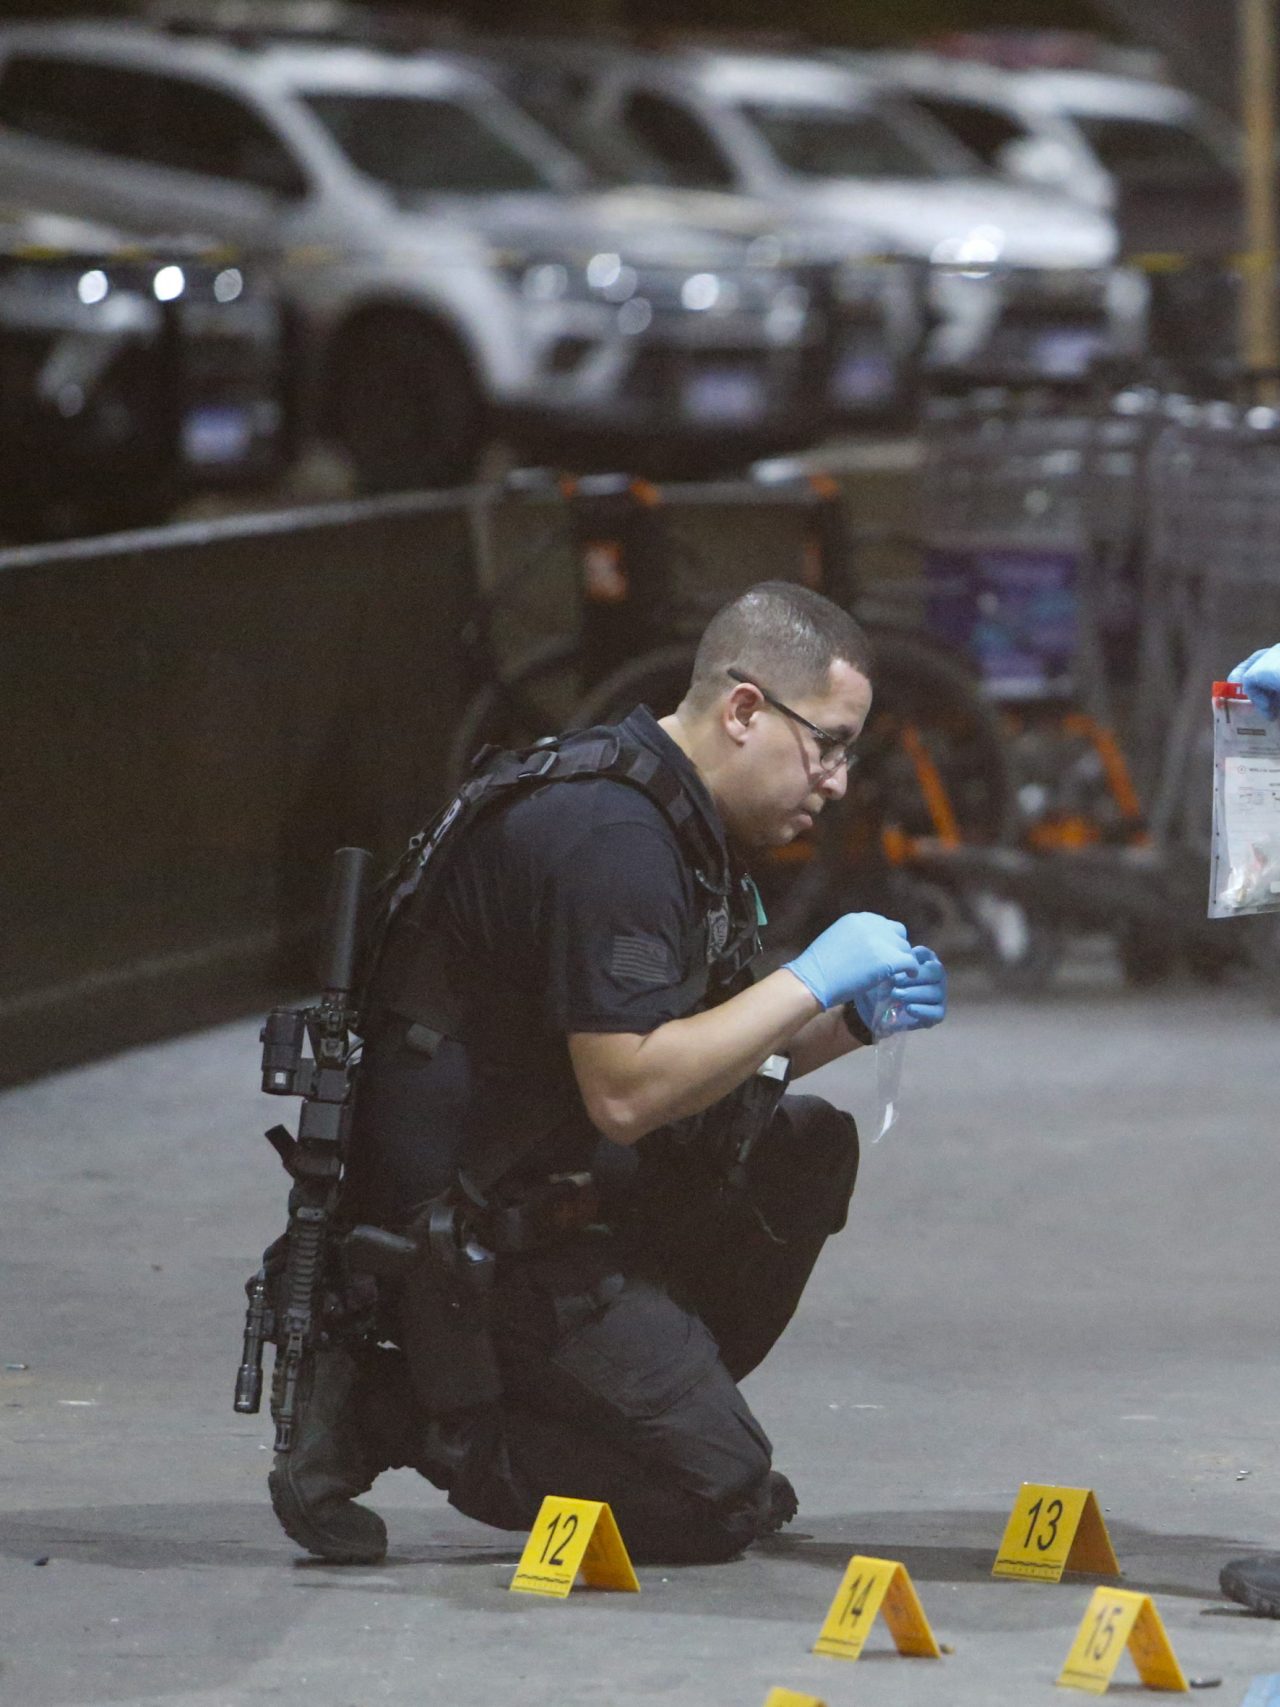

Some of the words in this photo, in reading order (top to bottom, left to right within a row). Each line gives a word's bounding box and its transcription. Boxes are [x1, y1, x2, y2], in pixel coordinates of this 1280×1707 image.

[539, 1512, 578, 1566] 12
[1023, 1497, 1063, 1551] 13
[839, 1573, 876, 1628] 14
[1084, 1605, 1123, 1661] 15
